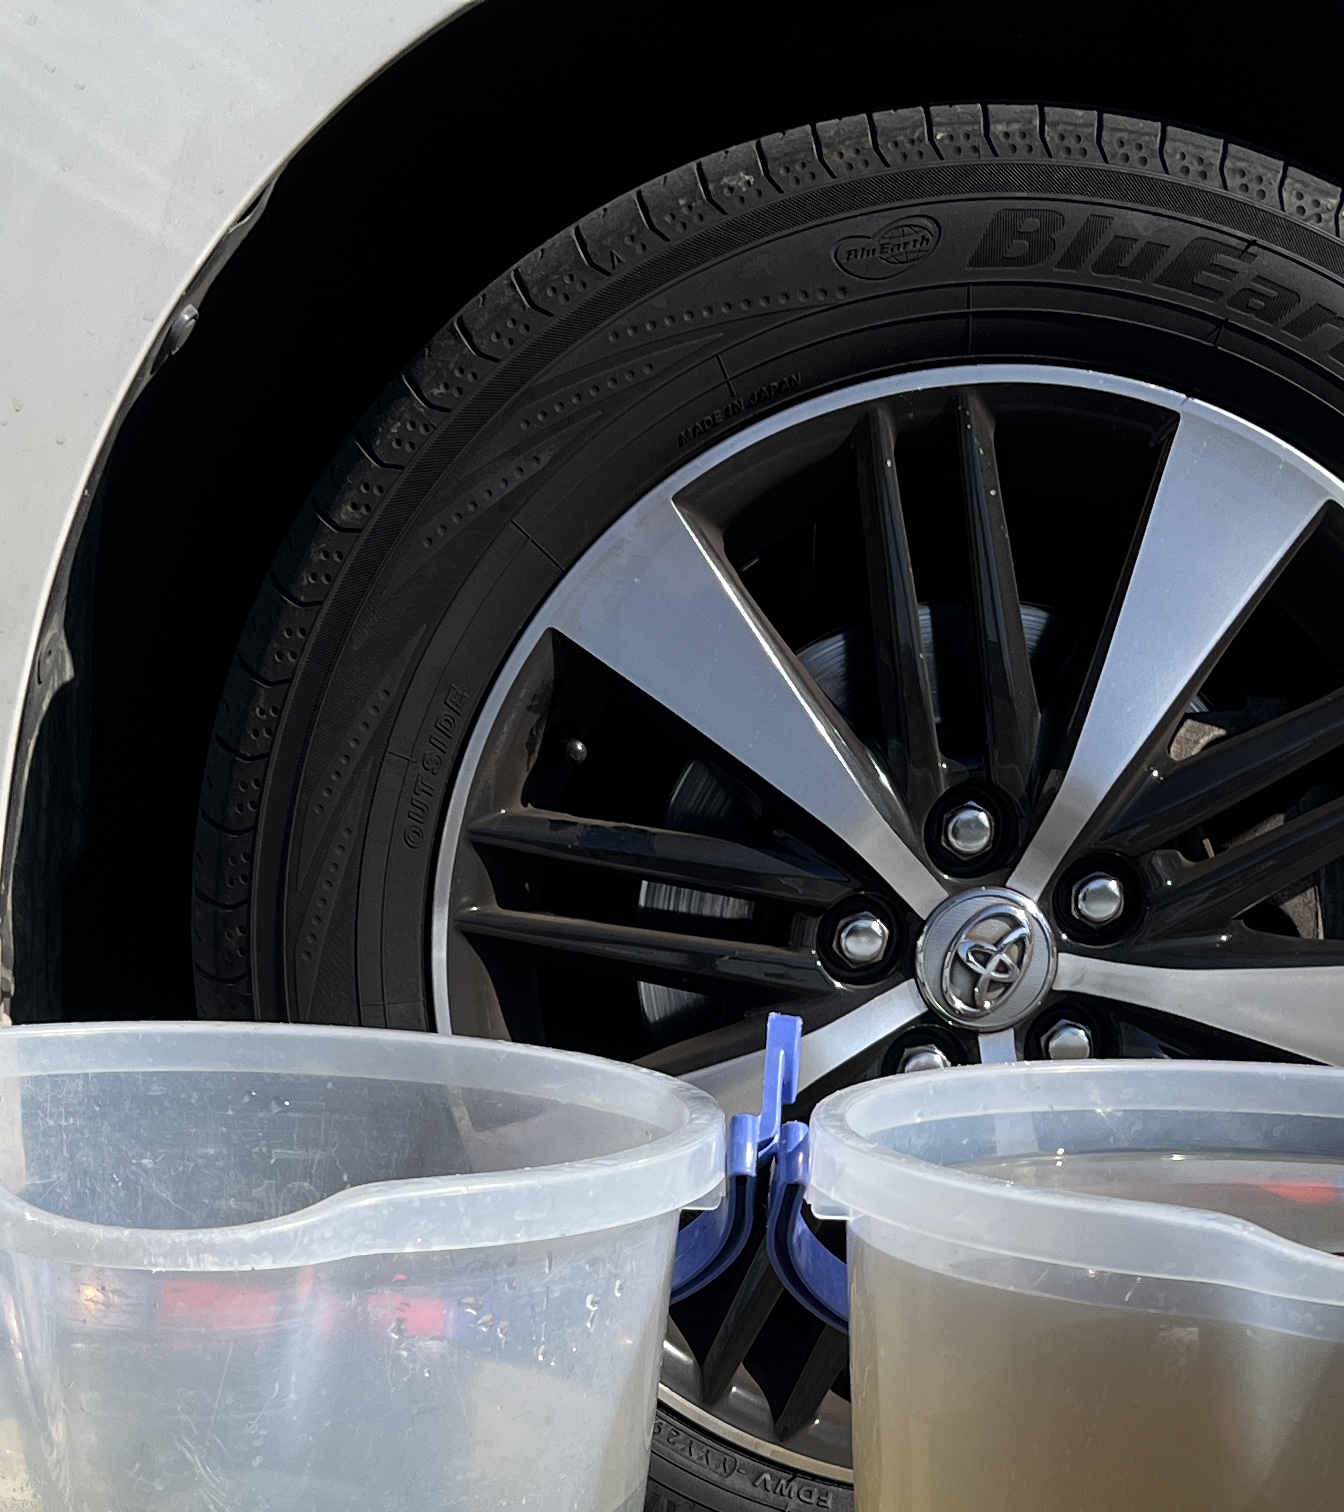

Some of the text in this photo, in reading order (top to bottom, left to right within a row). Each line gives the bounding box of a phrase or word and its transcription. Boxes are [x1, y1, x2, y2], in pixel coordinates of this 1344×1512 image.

[844, 234, 931, 263] BluEarth
[677, 371, 803, 448] MADE IN JAPAN
[403, 683, 470, 850] OUTSIDE
[753, 1471, 834, 1510] FDWV
